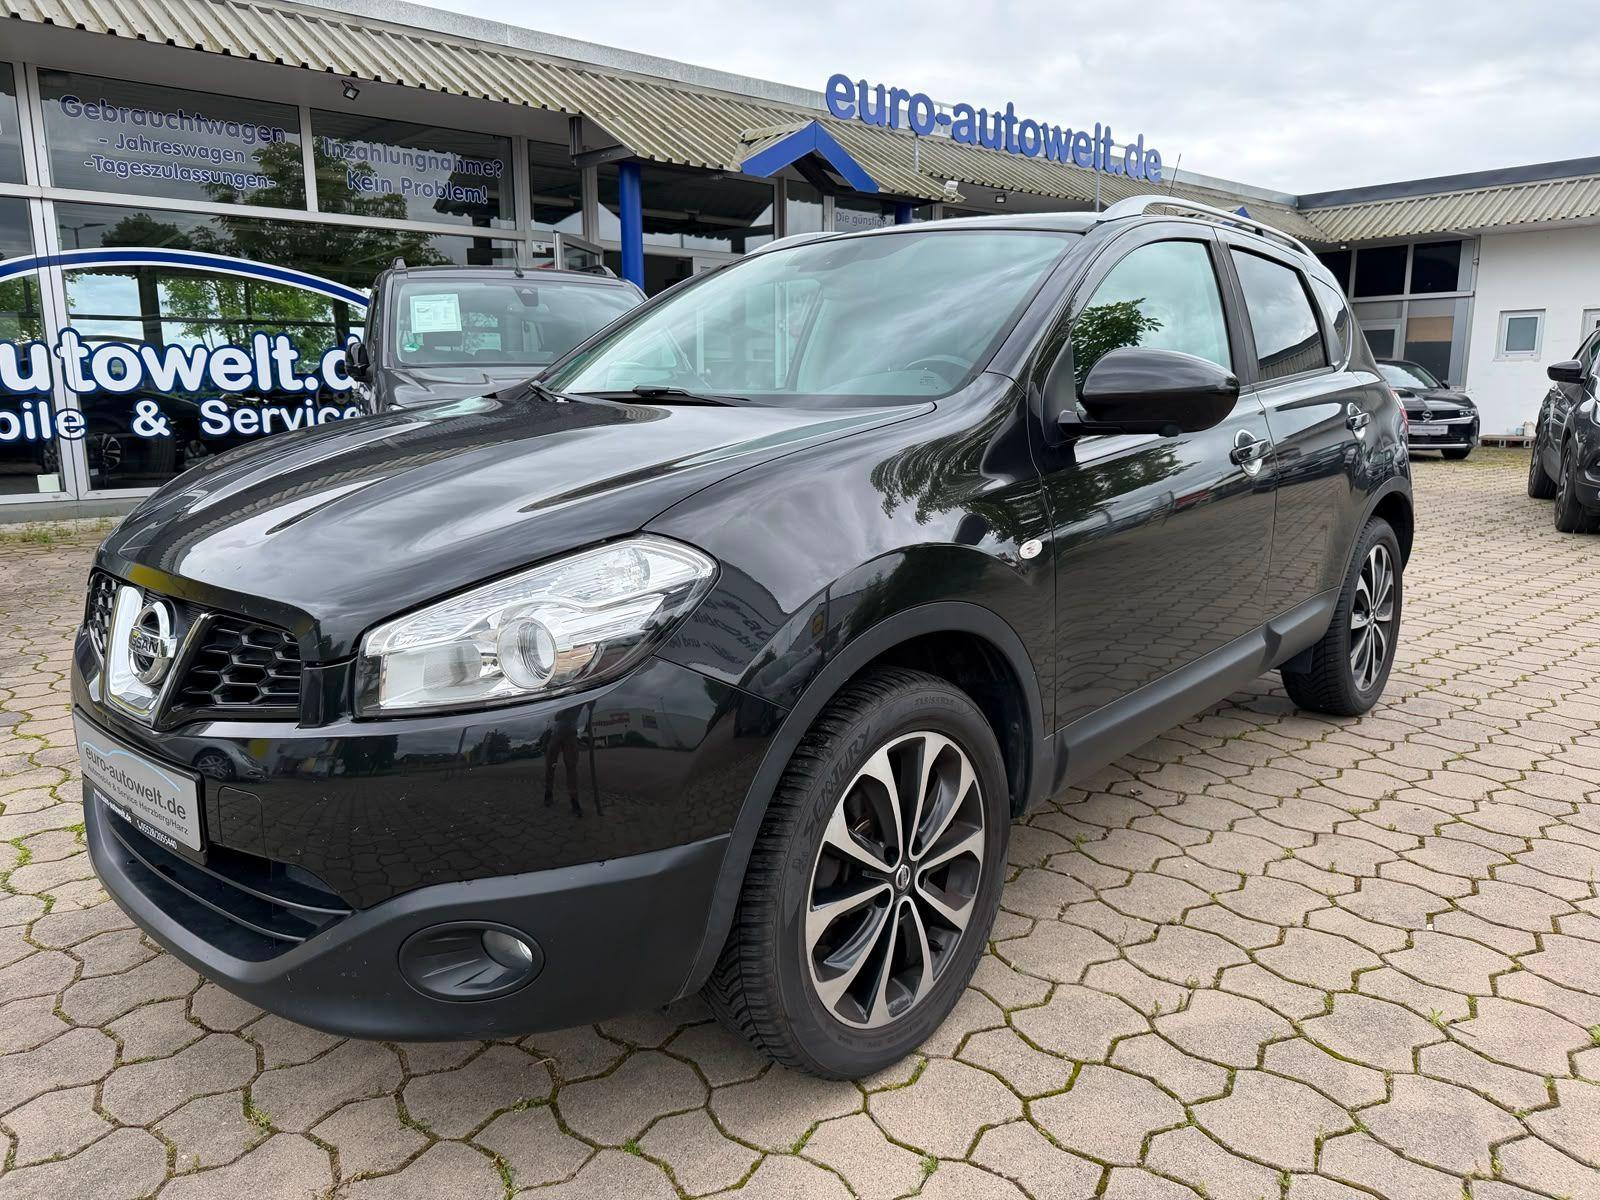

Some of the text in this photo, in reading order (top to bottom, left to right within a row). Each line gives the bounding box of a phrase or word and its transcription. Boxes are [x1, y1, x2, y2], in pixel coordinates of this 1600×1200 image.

[59, 94, 287, 144] Gebrauchtwagen
[826, 73, 1162, 183] euro-autowelt.de
[115, 133, 246, 165] Jahreswagen
[322, 136, 504, 177] Inzahlungnahme?
[83, 155, 277, 190] -Tageszulassungen-
[346, 169, 489, 204] Kein Problem!
[835, 211, 850, 224] Die
[132, 400, 170, 437] &
[85, 746, 187, 820] euro-autowelt.de
[139, 801, 189, 835] Herzberg/Harz
